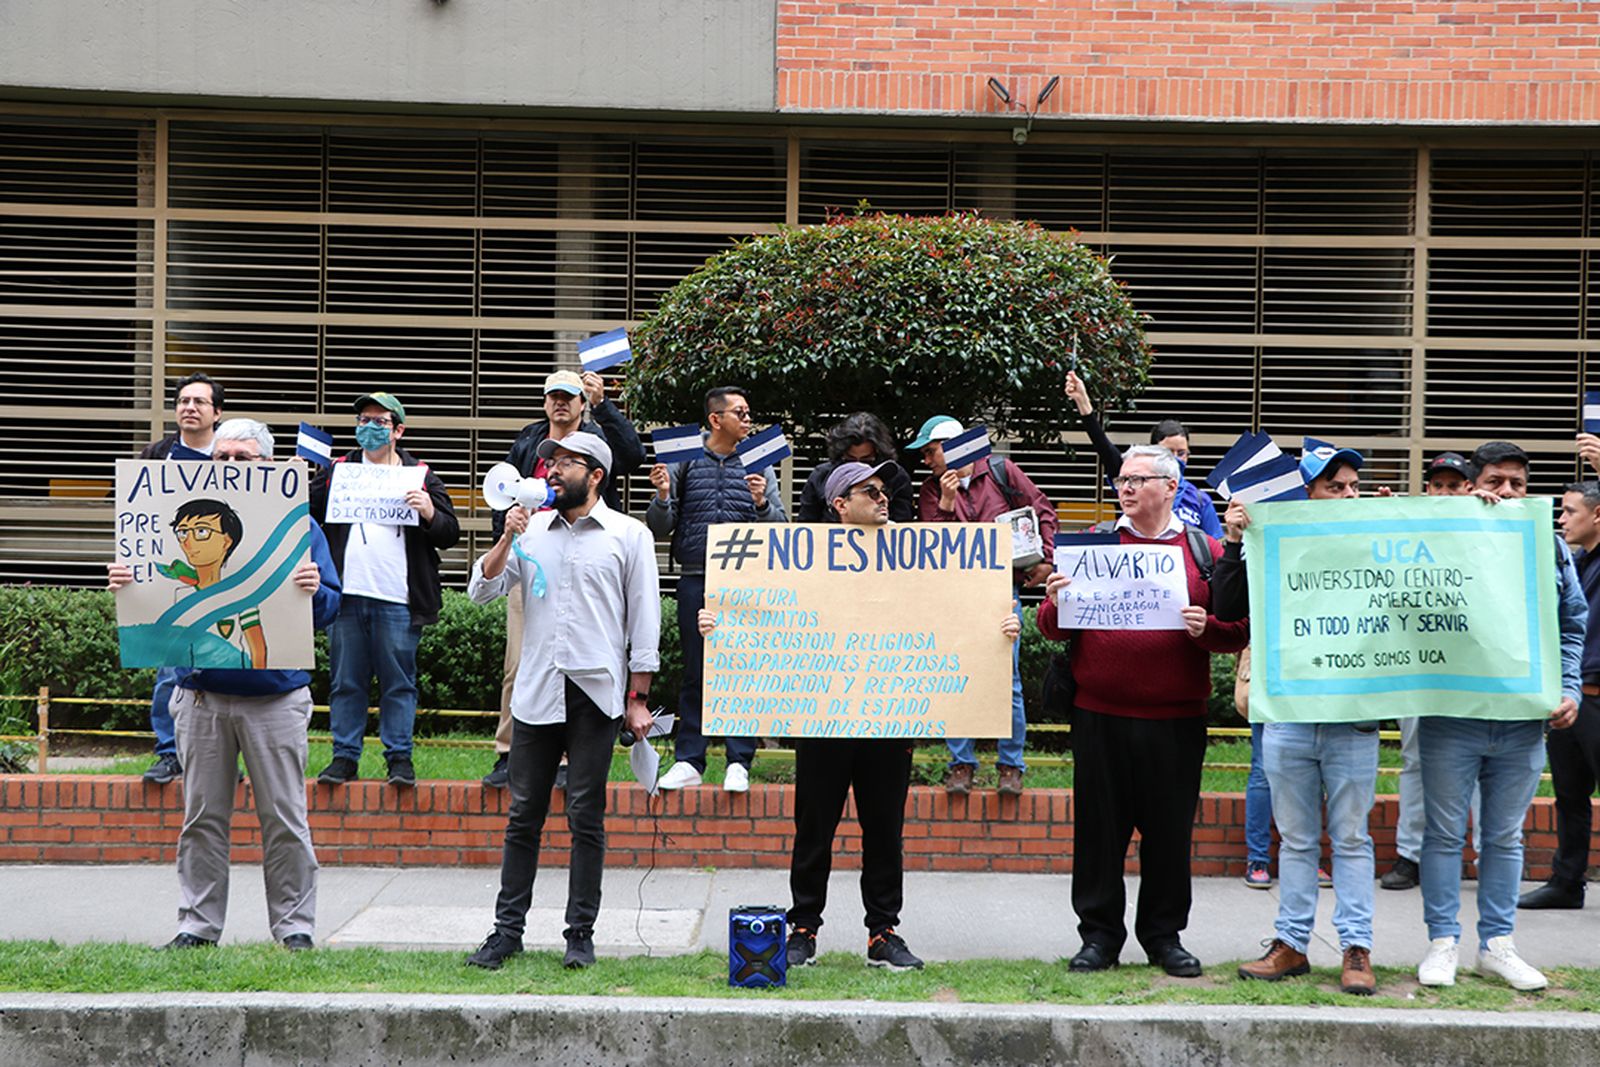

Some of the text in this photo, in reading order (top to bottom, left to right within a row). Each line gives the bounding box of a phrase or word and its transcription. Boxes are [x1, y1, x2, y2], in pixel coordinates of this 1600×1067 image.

[127, 464, 299, 503] ALVARITO
[119, 512, 161, 534] PRE
[332, 506, 413, 521] DICTADURA
[120, 538, 164, 558] SEN
[828, 528, 869, 572] ES
[876, 527, 1006, 571] NORMAL
[1371, 539, 1436, 564] UCA
[126, 562, 153, 583] E!
[1072, 550, 1175, 581] ALVARITO
[1288, 568, 1473, 591] UNIVERSIDAD CENTRO-
[1064, 588, 1172, 603] PRESENTE
[1368, 591, 1468, 608] AMERICANA
[715, 609, 819, 628] ASESINATOS
[1294, 614, 1469, 636] EN TODO AMAR Y SERVIR
[845, 632, 937, 651] RELIGIOSA
[866, 654, 961, 673] FORZOSAS
[1374, 650, 1411, 666] SOMOS
[1418, 650, 1446, 664] UCA
[844, 676, 856, 694] Y
[864, 675, 969, 695] REPRESION
[828, 698, 851, 716] DE
[861, 698, 931, 717] ESTADO
[769, 719, 793, 736] DE
[801, 719, 947, 737] UNIVERSIDADES
